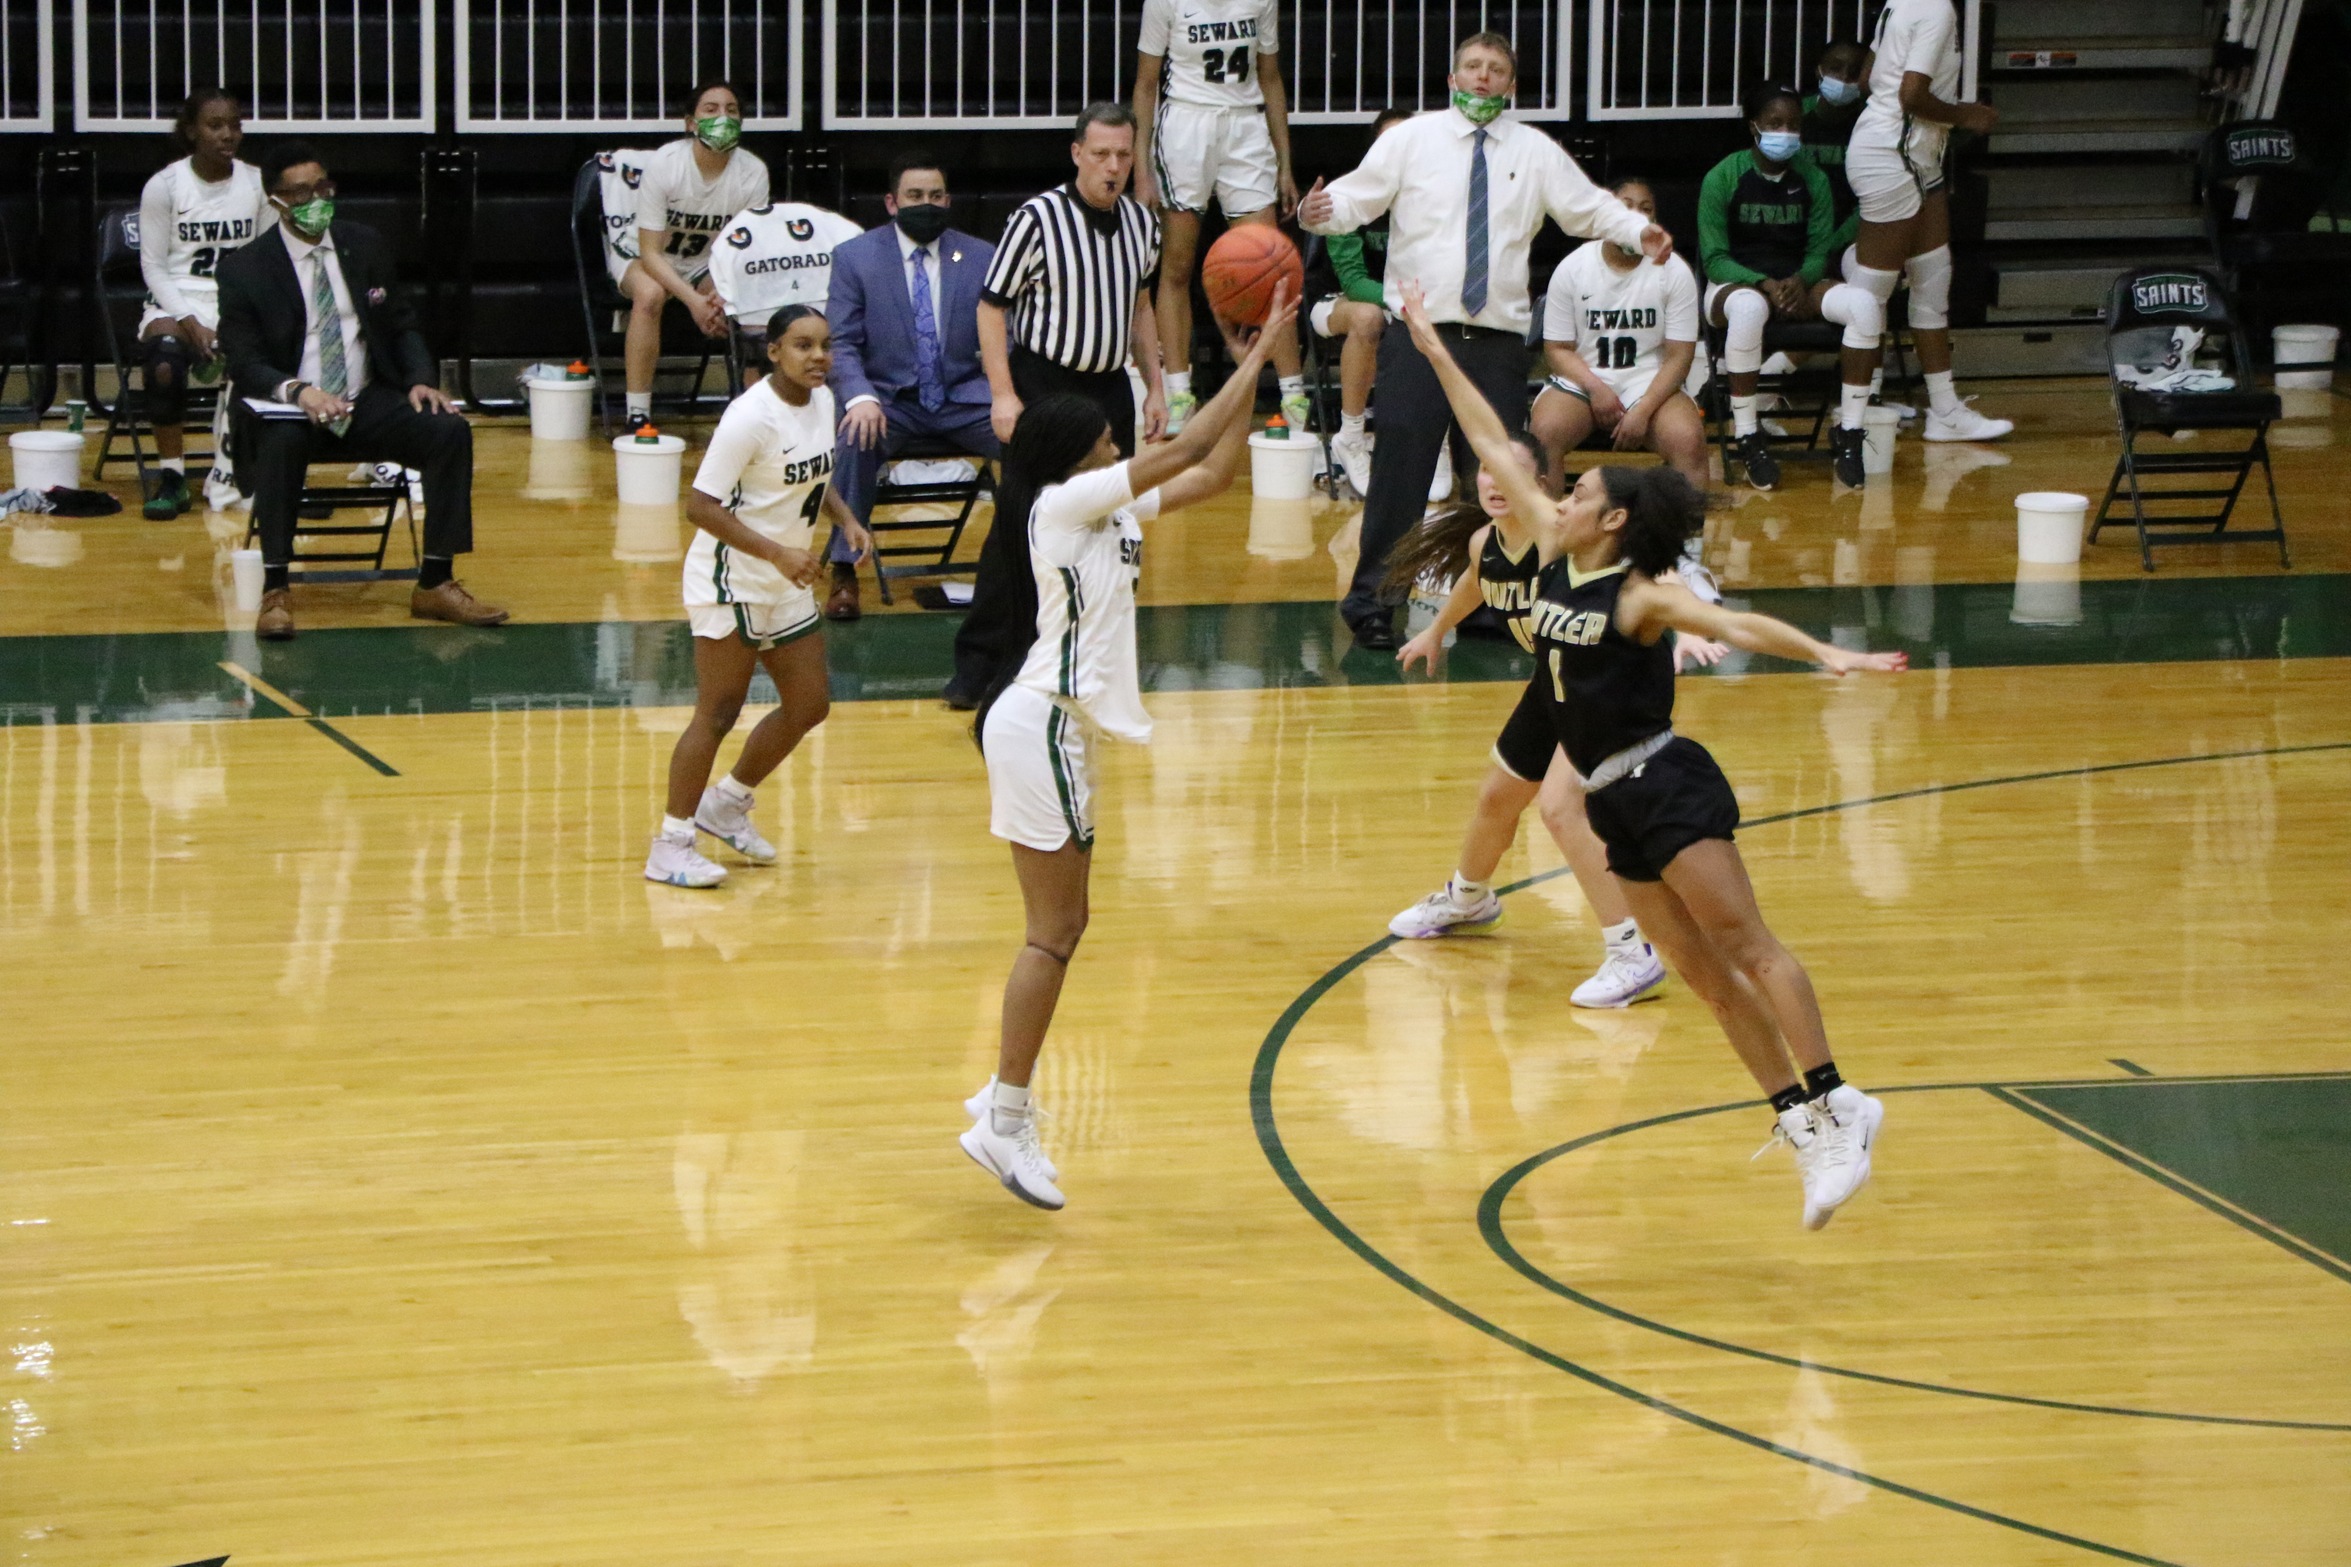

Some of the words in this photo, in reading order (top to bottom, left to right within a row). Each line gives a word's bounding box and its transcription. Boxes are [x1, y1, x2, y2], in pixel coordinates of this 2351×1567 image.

[1188, 18, 1257, 44] SEWARD
[1203, 45, 1250, 84] 24
[2230, 138, 2291, 160] SAINTS
[665, 231, 710, 258] 13
[744, 251, 832, 276] GATORAD
[2136, 283, 2204, 307] SAINTS
[1586, 307, 1657, 331] EWARD
[1596, 336, 1638, 370] 10
[799, 482, 826, 529] 4
[1530, 599, 1608, 646] UTLER
[1548, 648, 1566, 703] 1
